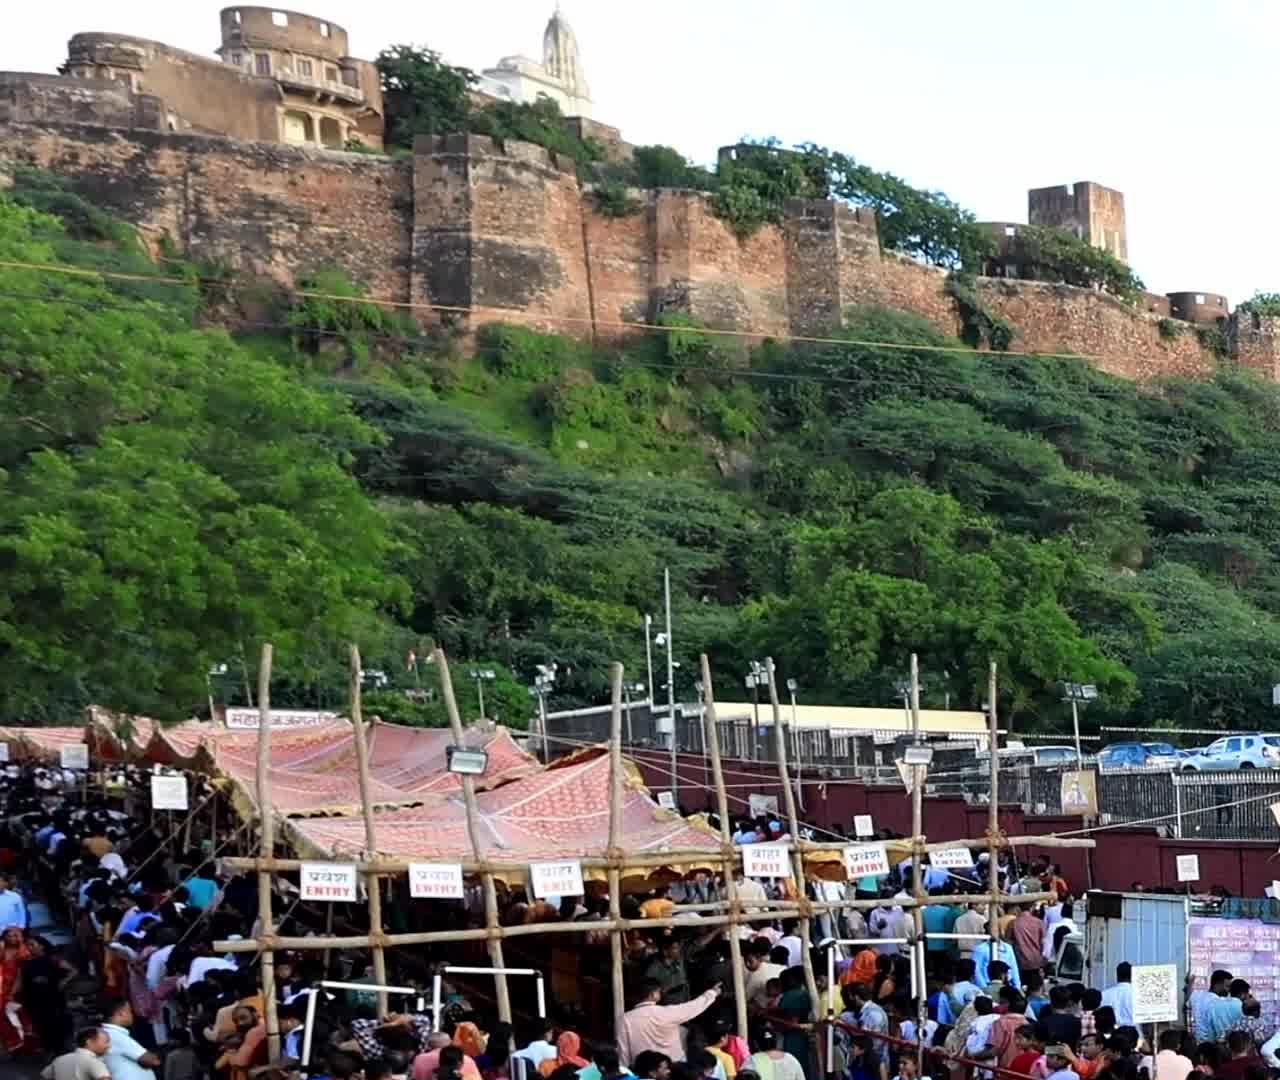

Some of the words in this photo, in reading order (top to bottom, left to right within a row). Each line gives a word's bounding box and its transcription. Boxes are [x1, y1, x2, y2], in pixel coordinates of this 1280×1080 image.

[751, 863, 781, 873] EXIT
[851, 864, 883, 875] ENTRY
[308, 870, 347, 883] प्रवेश
[306, 885, 351, 898] ENTRY
[416, 883, 457, 896] ENTRY
[543, 881, 575, 893] EXIT
